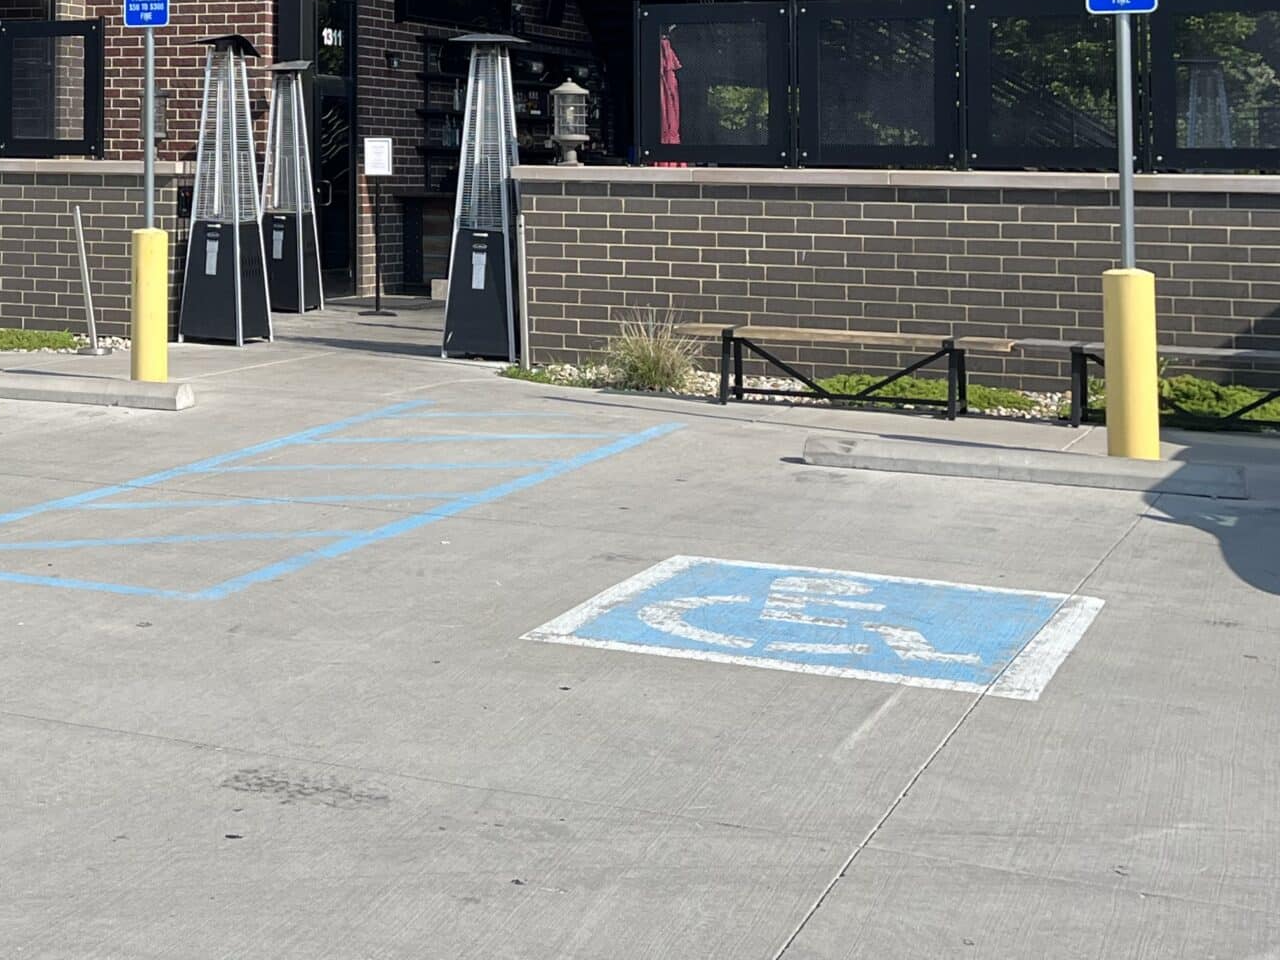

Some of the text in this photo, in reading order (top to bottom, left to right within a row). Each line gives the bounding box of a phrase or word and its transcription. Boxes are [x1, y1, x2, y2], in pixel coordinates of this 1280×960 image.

[141, 3, 149, 11] TO
[140, 12, 153, 21] FINE
[322, 27, 342, 46] 1311
